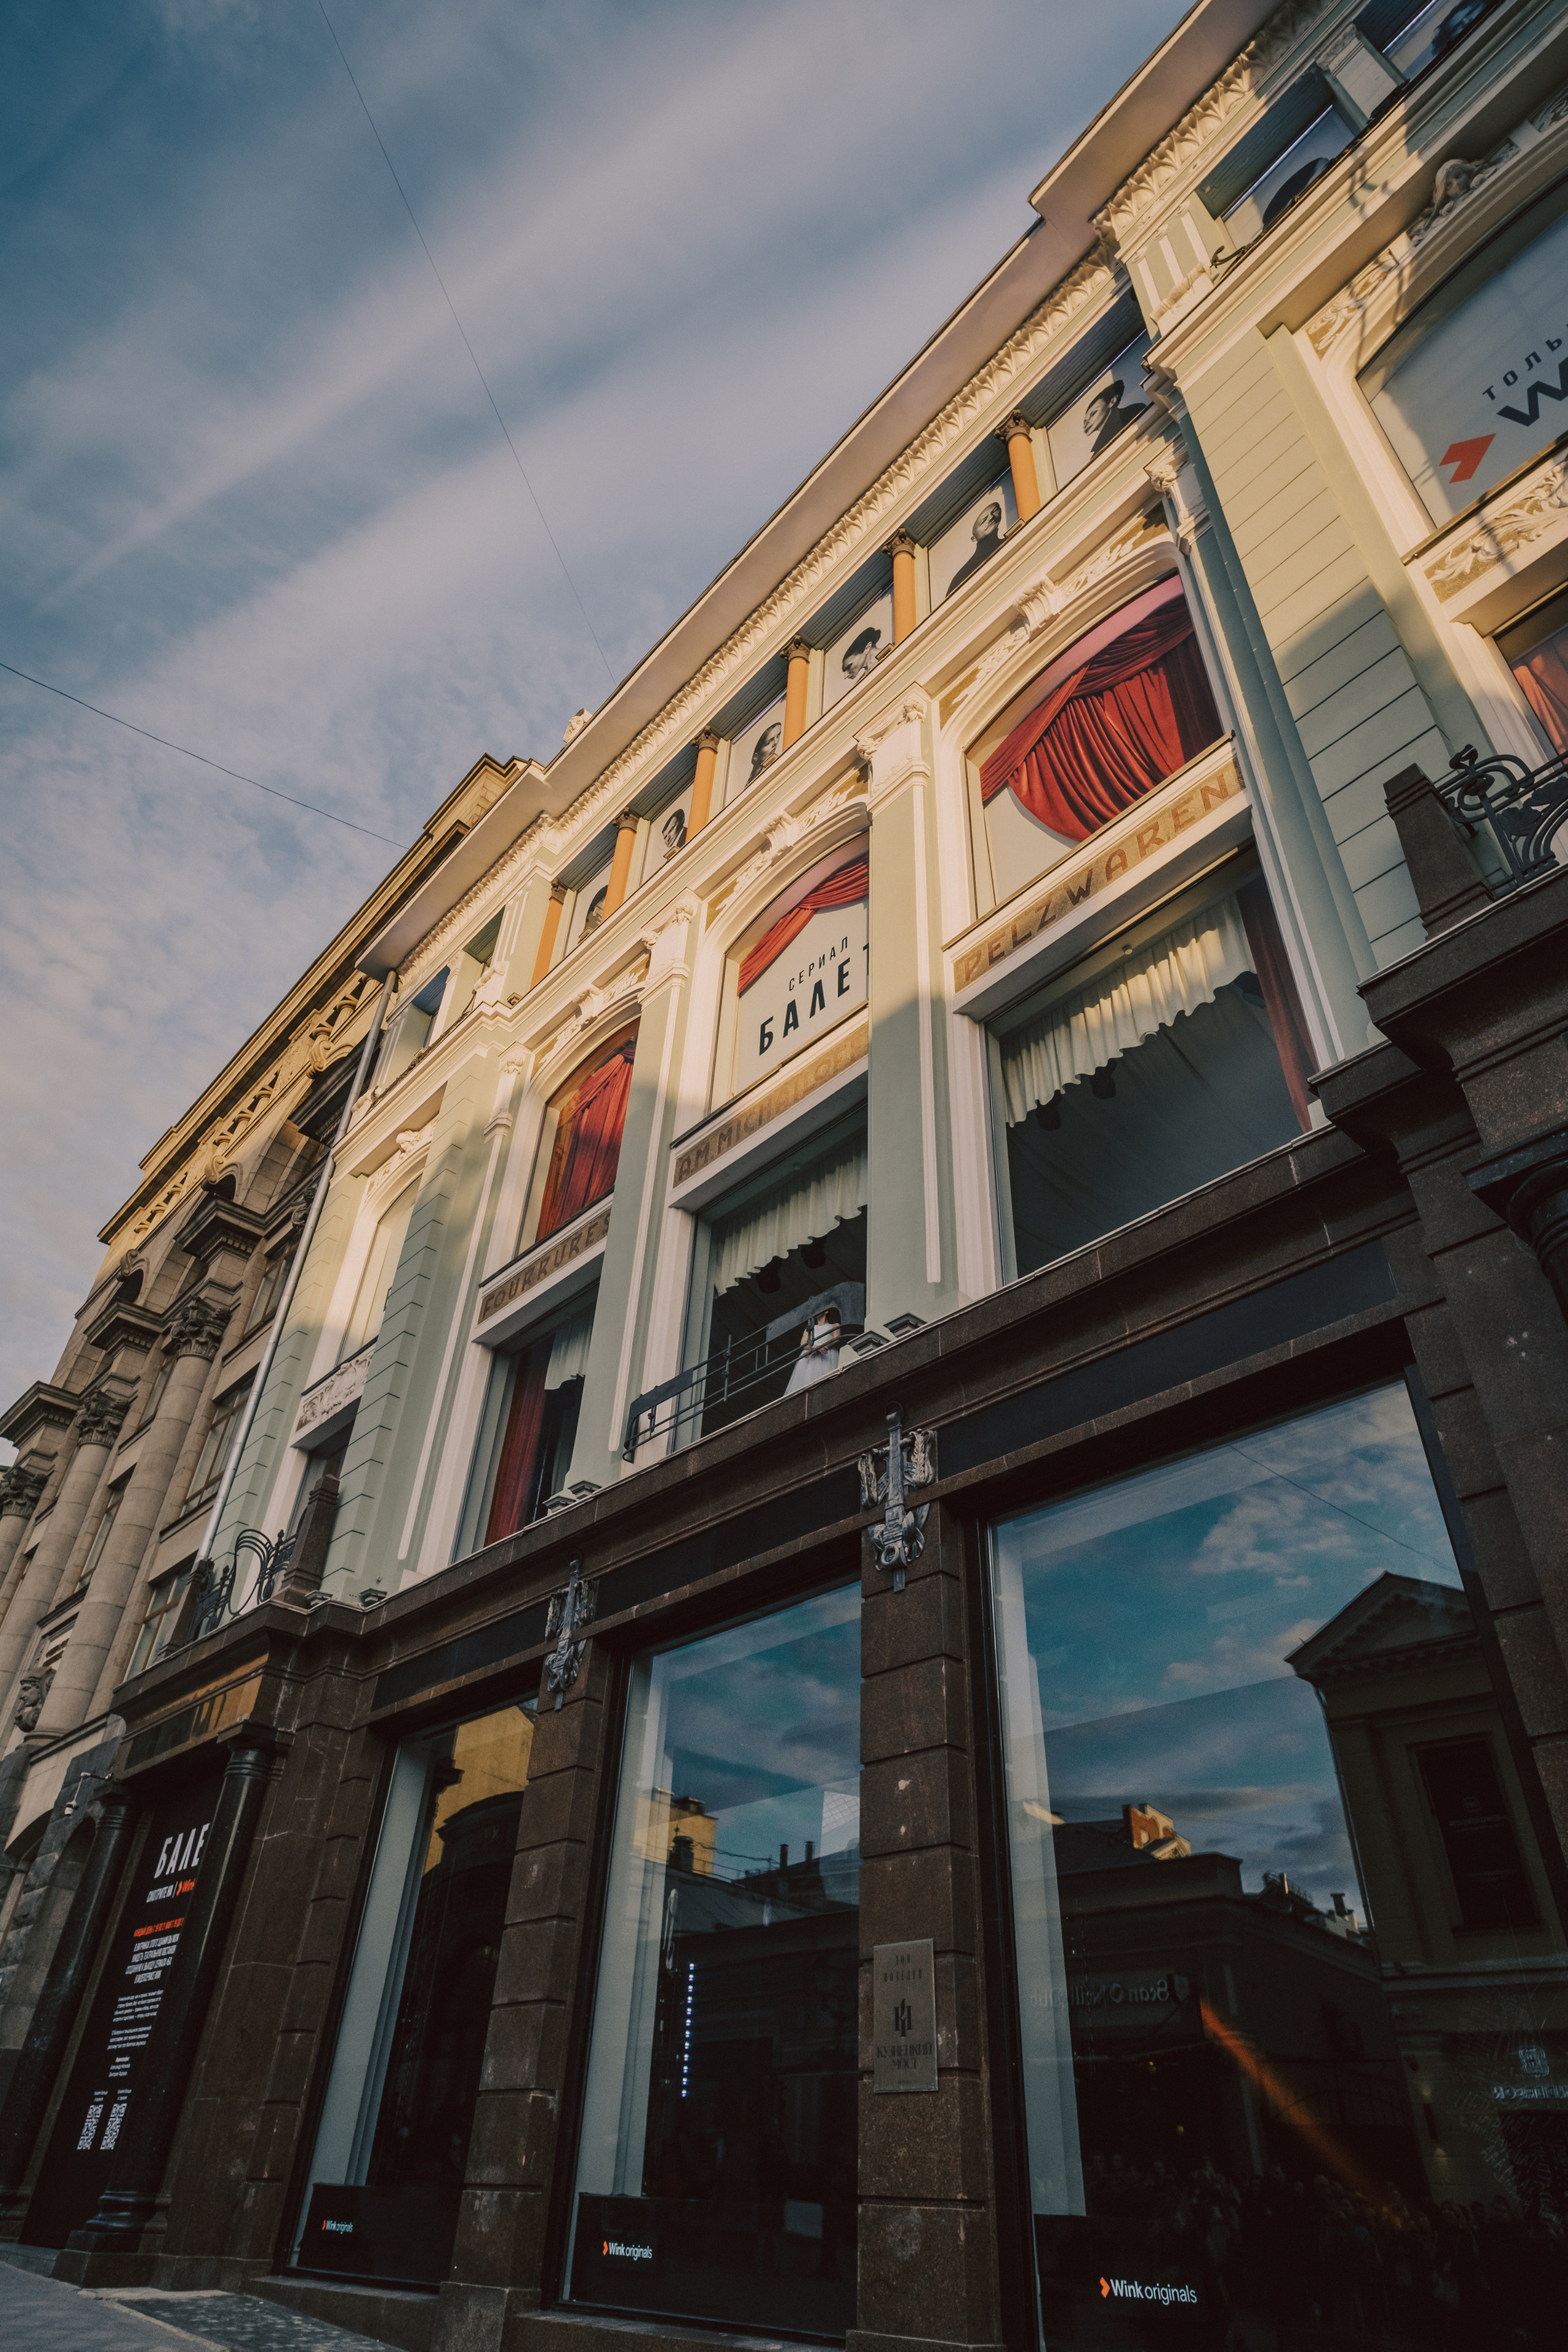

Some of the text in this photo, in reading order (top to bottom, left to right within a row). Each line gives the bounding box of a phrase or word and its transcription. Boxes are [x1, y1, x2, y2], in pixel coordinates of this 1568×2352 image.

[1482, 323, 1568, 401] ТОЛЬ
[964, 771, 1231, 982] PELZWAREN
[789, 937, 848, 991] СЕРИАЛ
[326, 2220, 353, 2234] Wink originals
[609, 2242, 652, 2261] Wink originals
[1110, 2278, 1197, 2305] Wink originals
